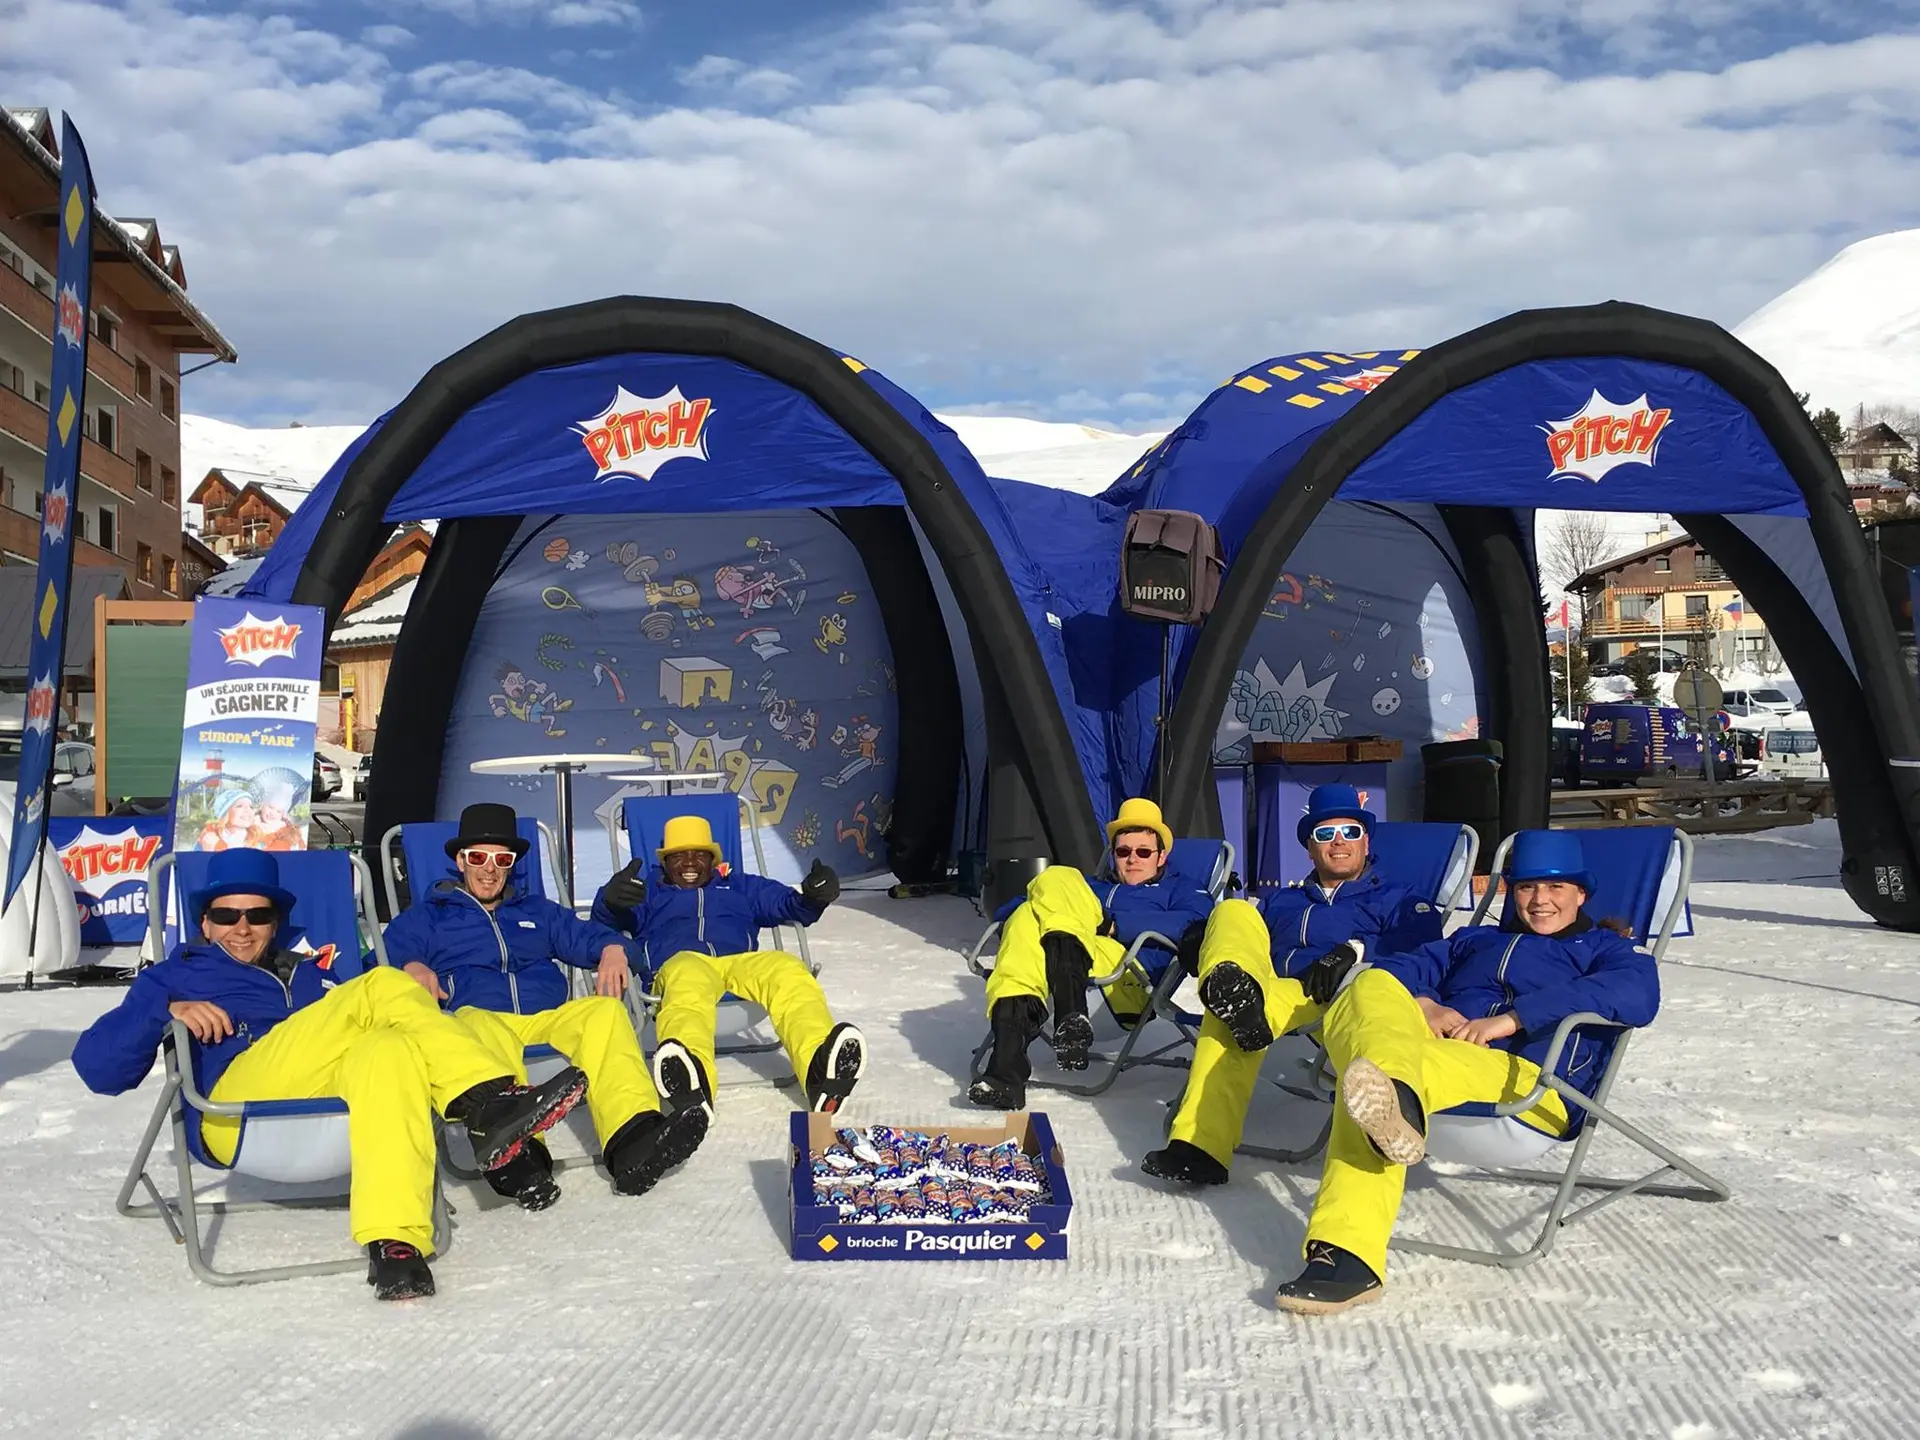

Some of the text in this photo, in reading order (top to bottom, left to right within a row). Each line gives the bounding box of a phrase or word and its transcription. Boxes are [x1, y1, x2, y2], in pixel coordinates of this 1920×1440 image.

[200, 683, 310, 698] UN SÉJOUR EN FAMILLE
[215, 694, 288, 714] GAGNER
[847, 1230, 1016, 1254] brioche Pasquier
